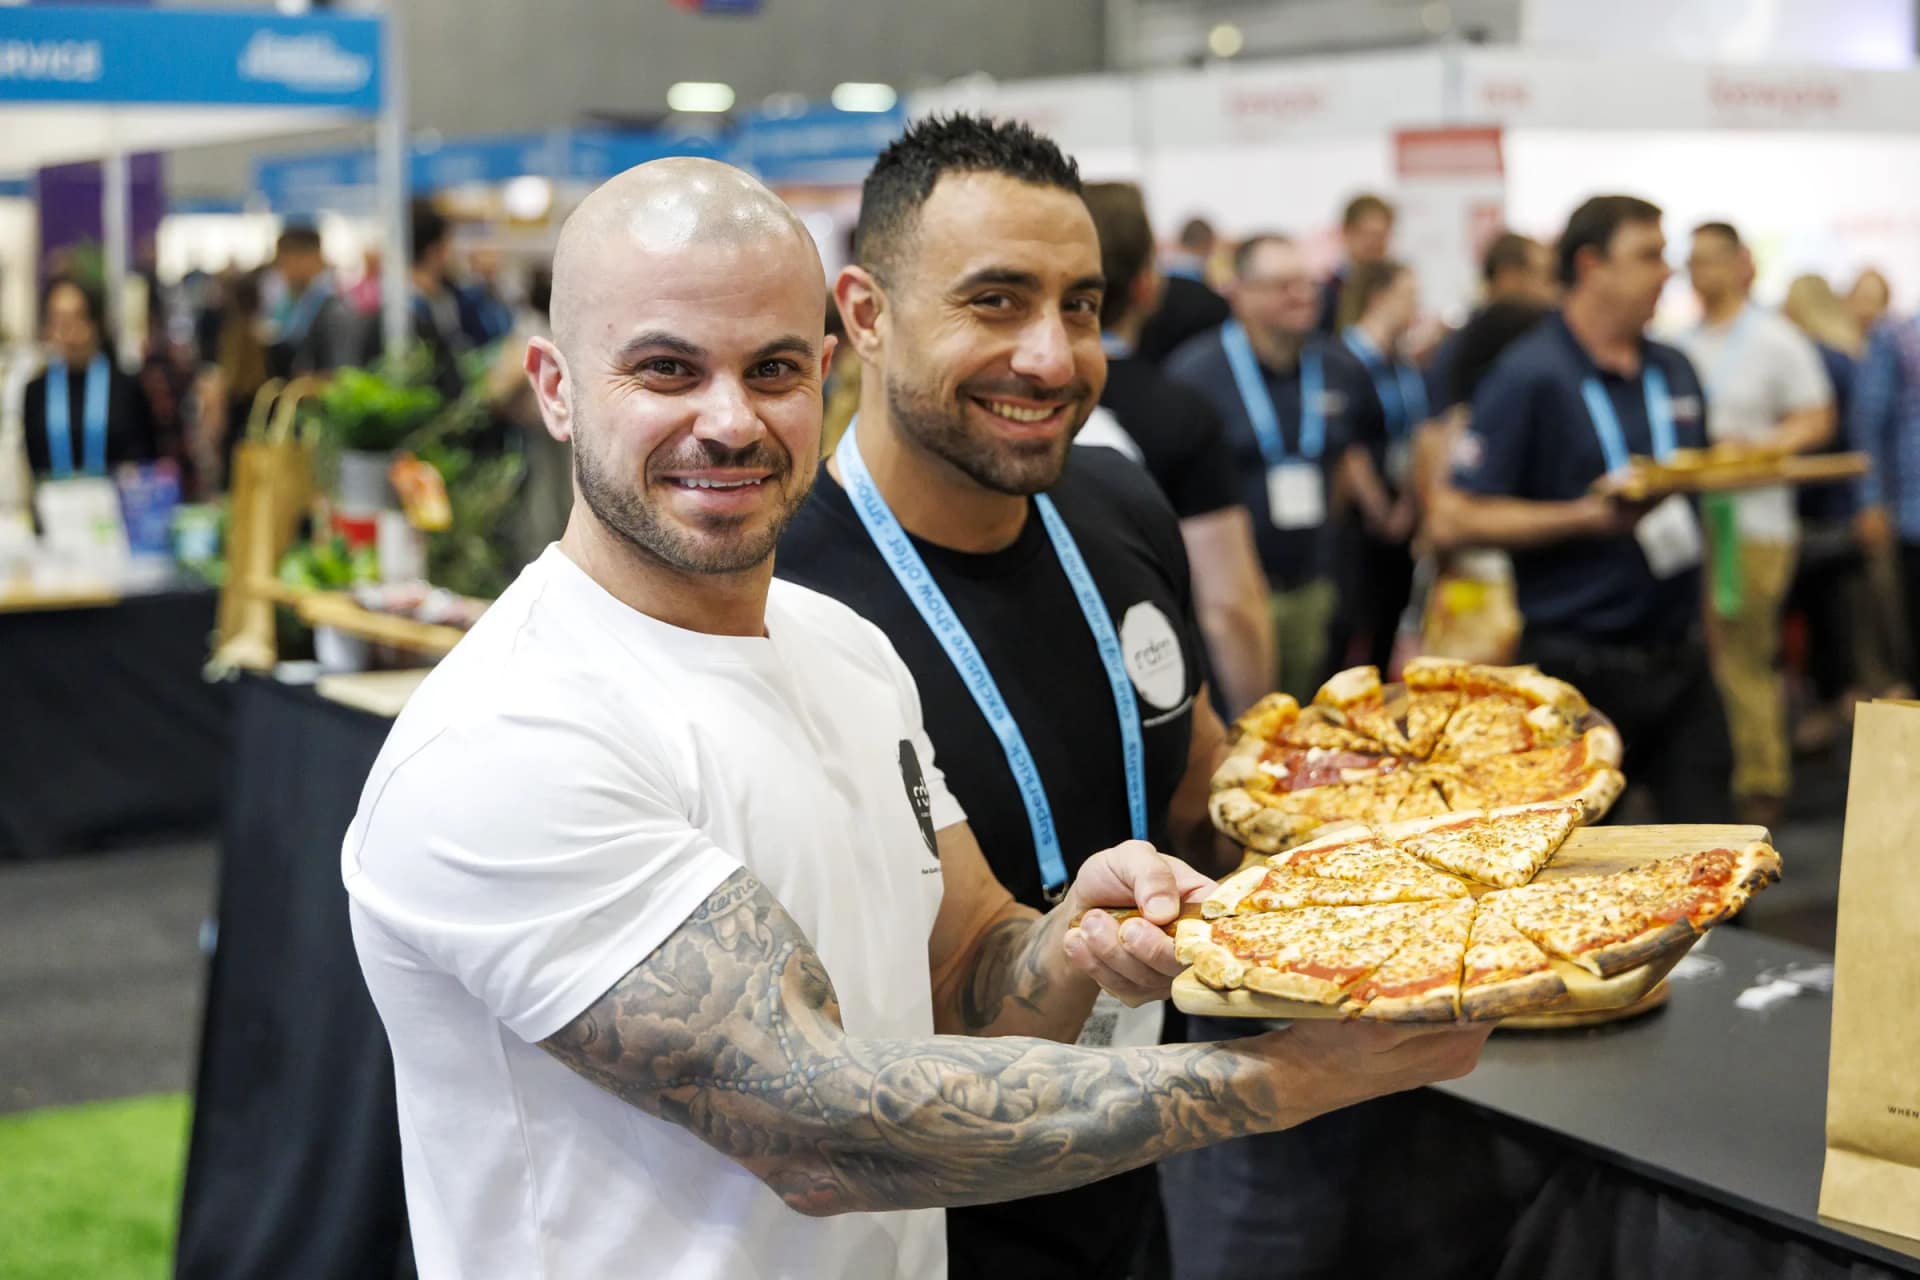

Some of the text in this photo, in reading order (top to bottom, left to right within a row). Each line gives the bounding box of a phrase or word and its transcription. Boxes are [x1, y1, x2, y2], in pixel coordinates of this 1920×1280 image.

[887, 537, 922, 581] offer
[916, 584, 956, 632] show
[951, 635, 1005, 721] exclusive
[1010, 743, 1053, 846] superkick
[1887, 1105, 1919, 1120] WHEN
